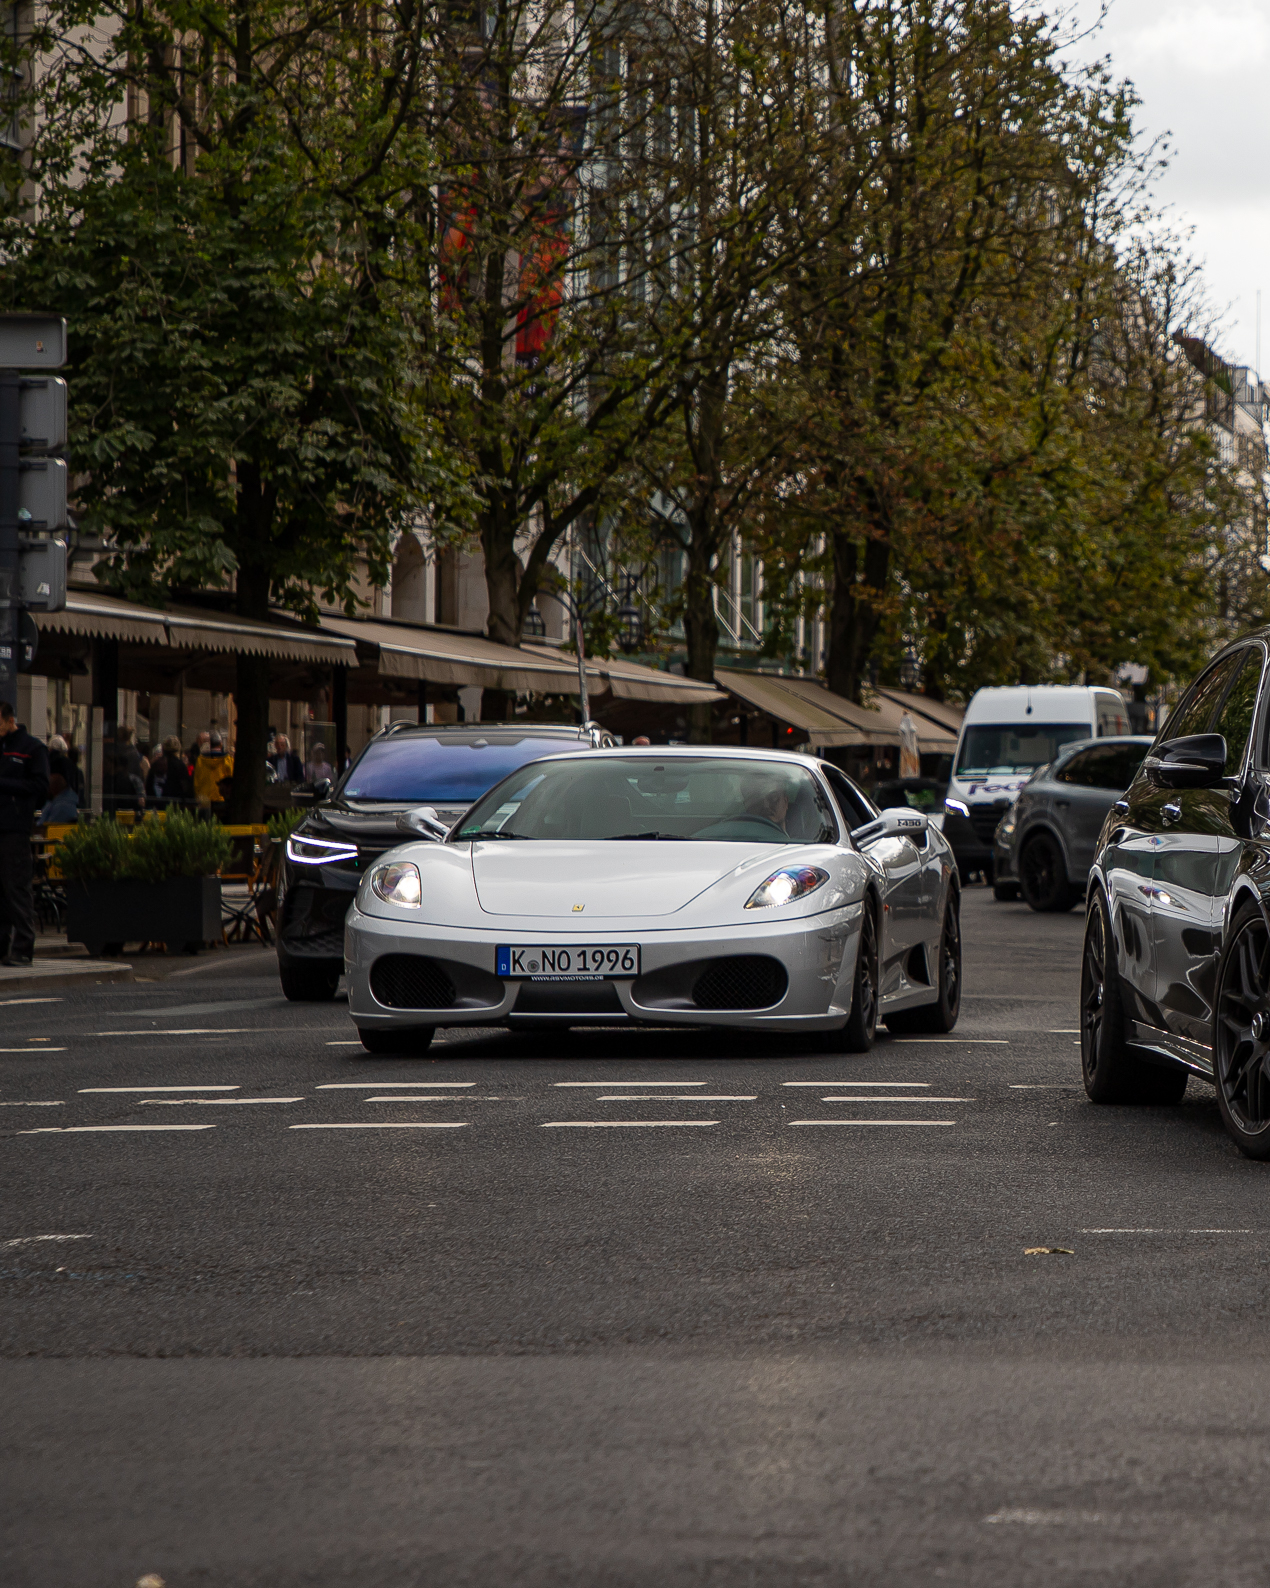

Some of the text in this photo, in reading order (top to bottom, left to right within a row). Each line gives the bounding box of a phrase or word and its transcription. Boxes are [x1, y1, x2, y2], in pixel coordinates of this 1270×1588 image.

[968, 780, 1028, 795] Fed
[897, 818, 921, 827] F430
[512, 949, 635, 972] K NO 1996
[501, 963, 507, 971] D
